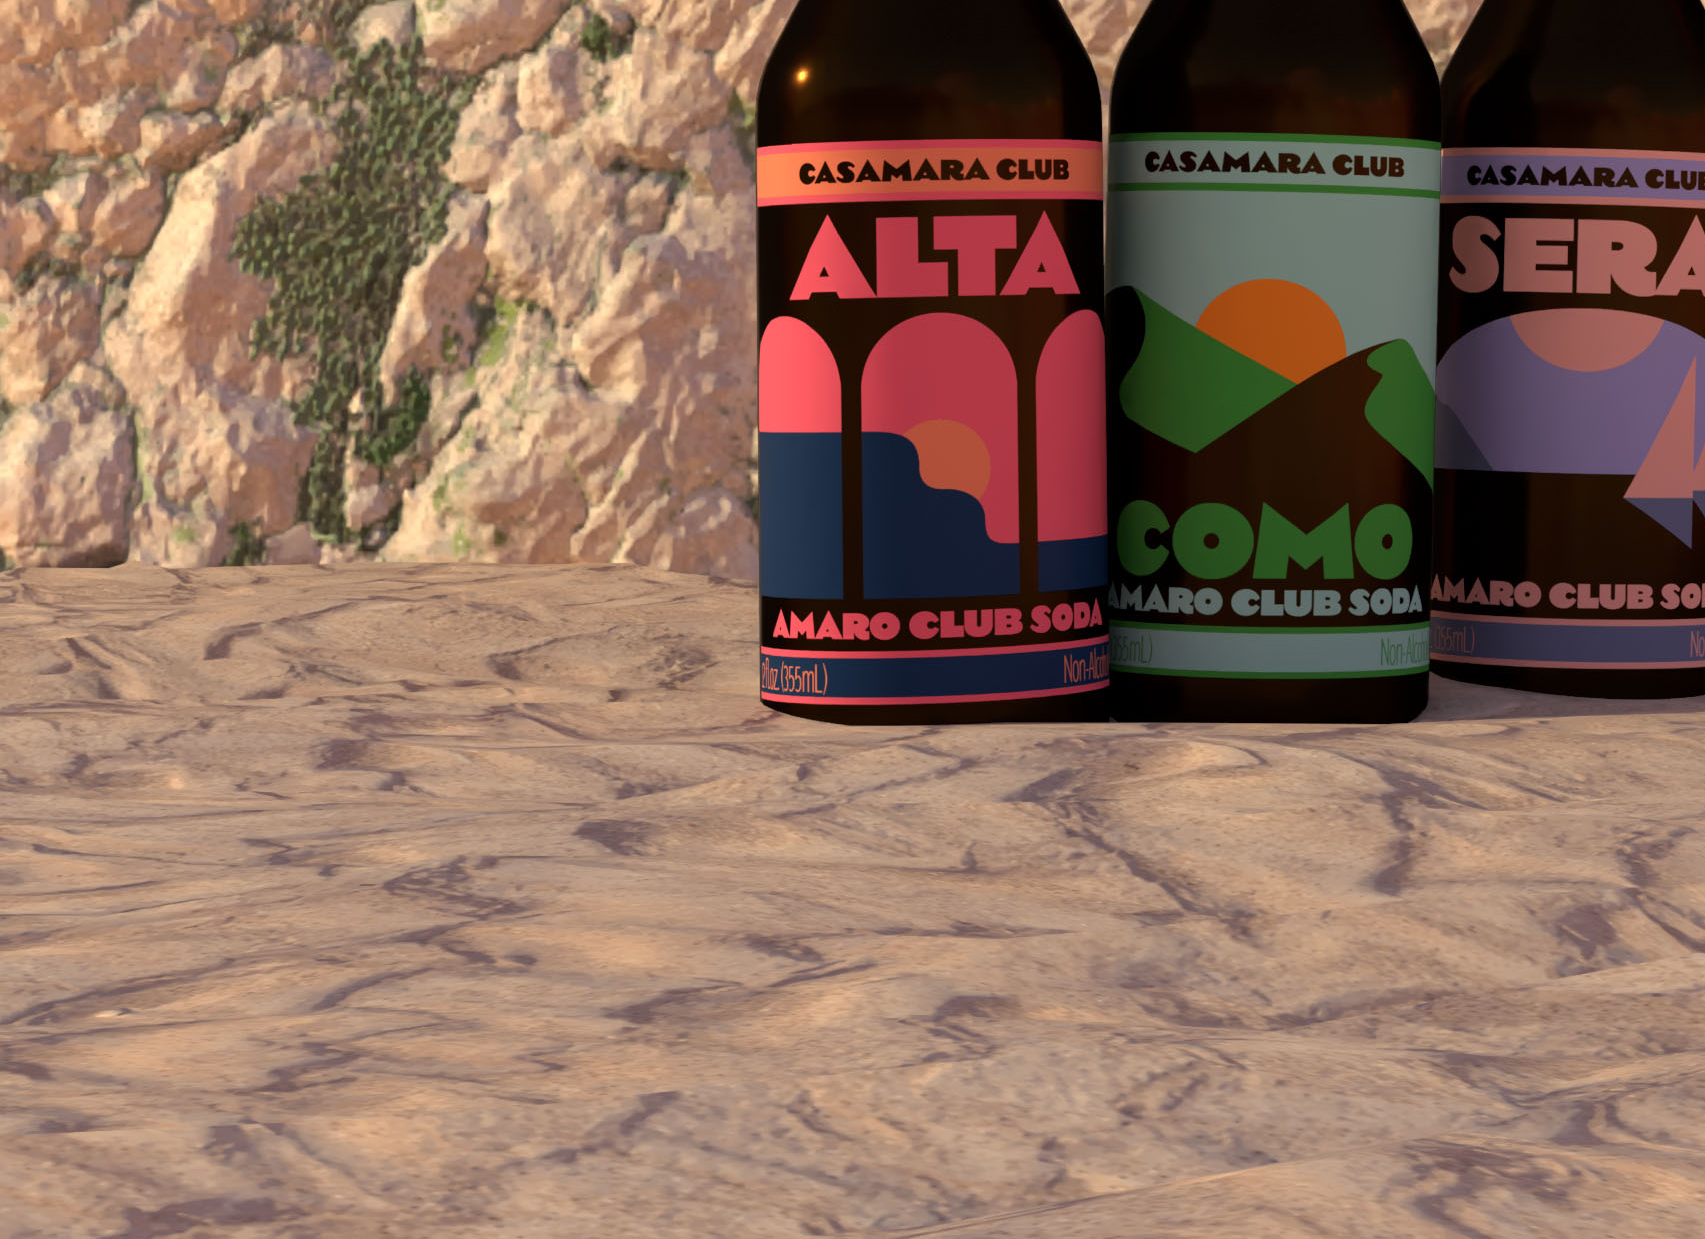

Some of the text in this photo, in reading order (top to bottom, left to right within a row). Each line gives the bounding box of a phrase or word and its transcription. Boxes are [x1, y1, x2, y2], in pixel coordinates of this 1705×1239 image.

[798, 158, 1070, 185] CASAMARA CLUB
[1144, 149, 1405, 179] CASAMARA CLUB
[1466, 164, 1639, 189] CASAMARA
[788, 210, 1081, 301] ALTA
[1117, 499, 1413, 581] COMO
[1107, 582, 1423, 617] AMARO CLUB SODA
[1430, 573, 1542, 609] AMARO
[1549, 581, 1654, 610] CLUB
[772, 597, 1103, 641] AMARO CLUB SODA
[780, 661, 828, 696] (355mL)
